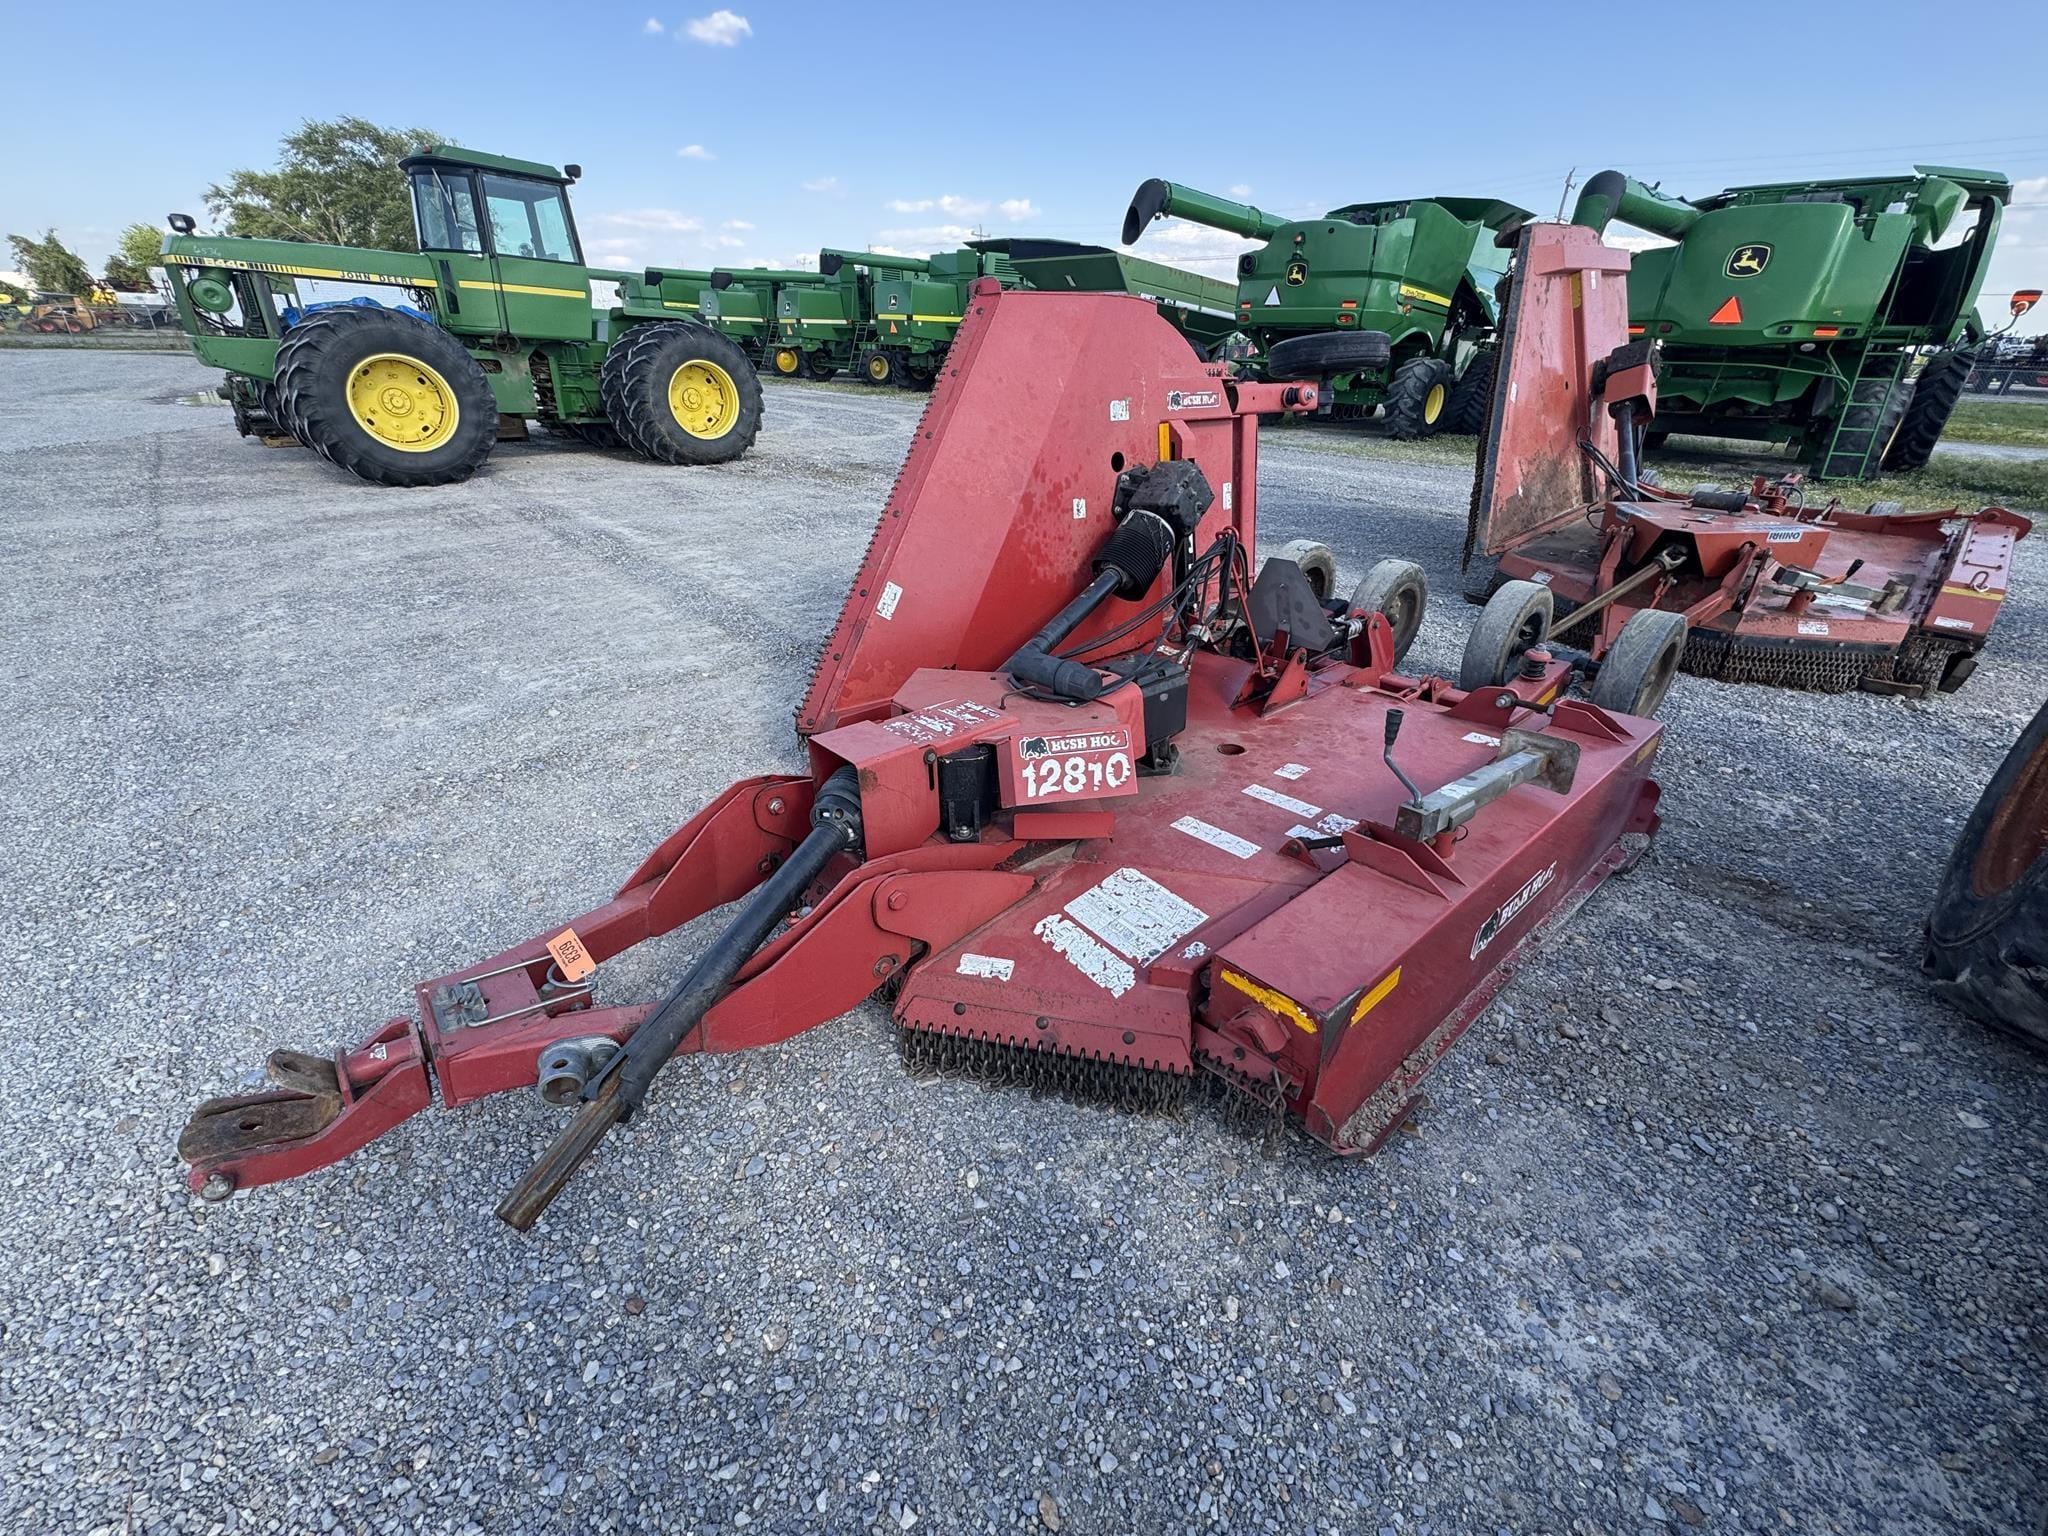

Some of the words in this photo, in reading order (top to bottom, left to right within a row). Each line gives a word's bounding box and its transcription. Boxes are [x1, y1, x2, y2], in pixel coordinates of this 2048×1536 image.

[340, 270, 370, 281] JOHN
[379, 274, 416, 286] DEERE
[1769, 531, 1801, 540] RHINO
[1050, 737, 1088, 752] BUSH
[1021, 752, 1131, 798] 12810
[559, 940, 581, 964] 8339
